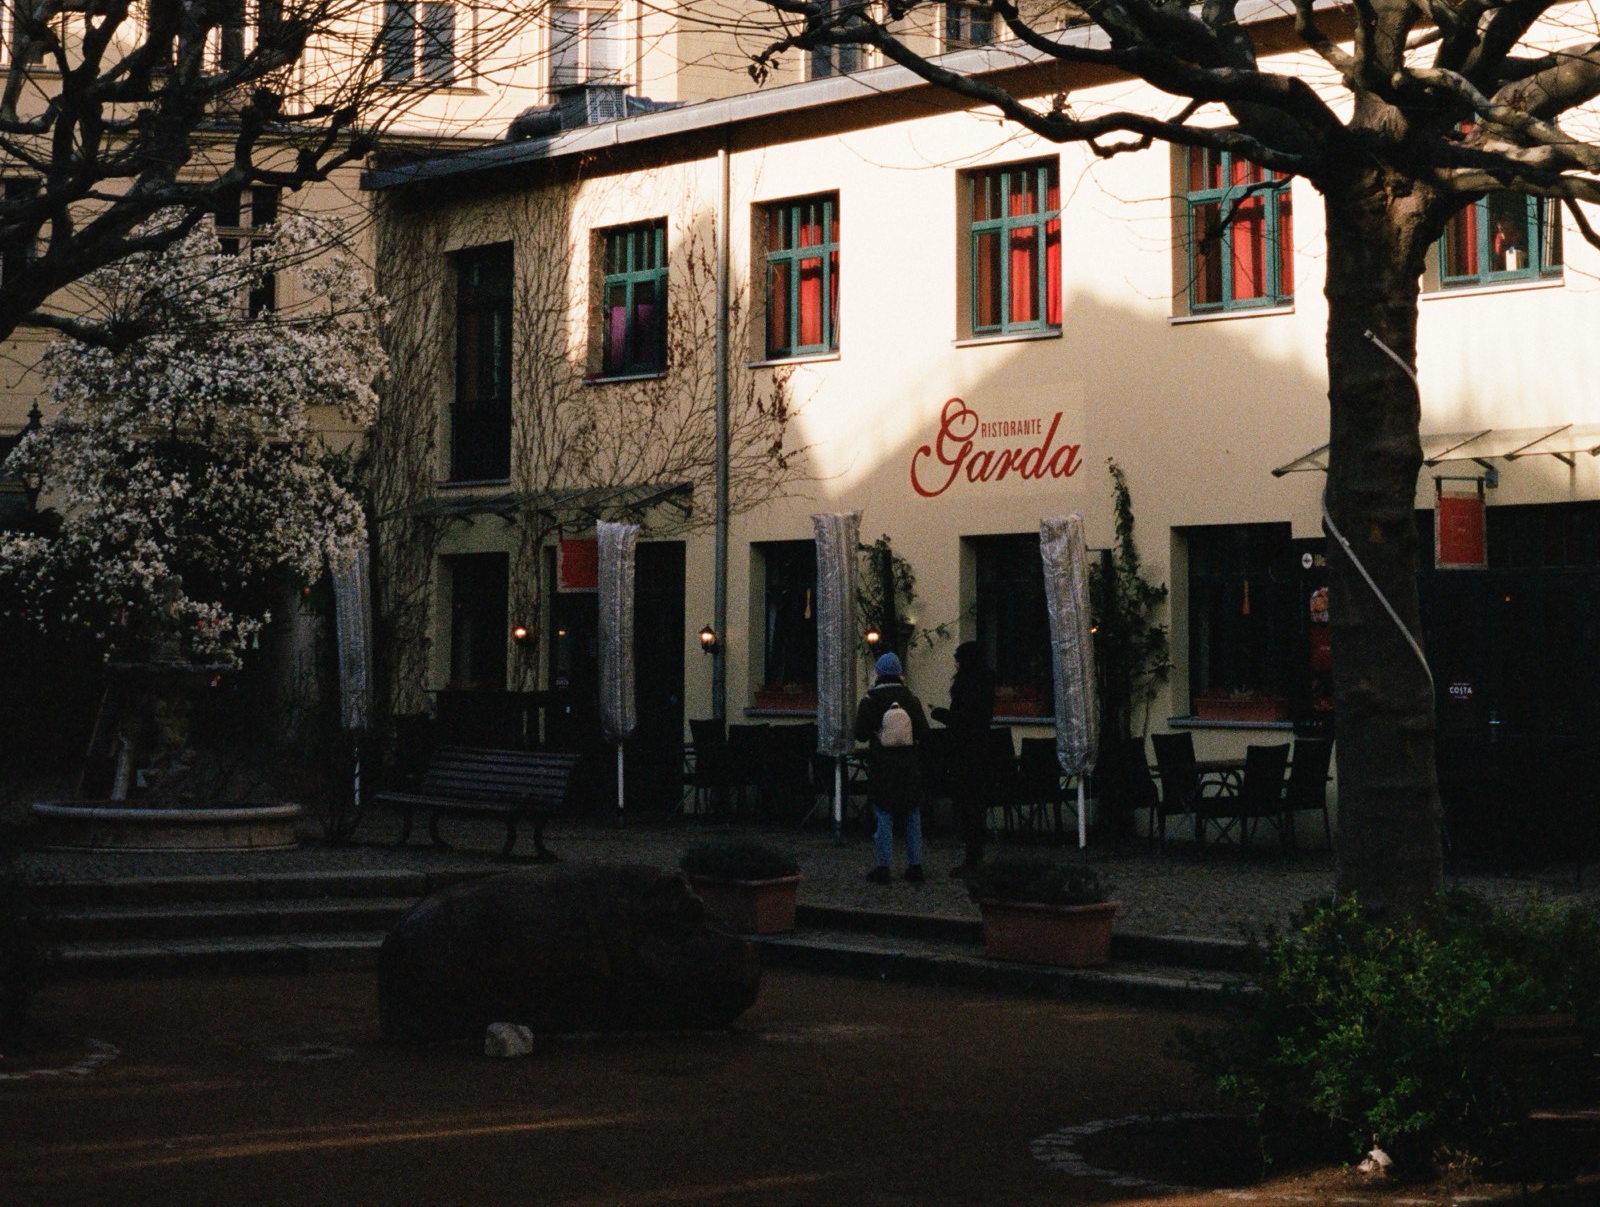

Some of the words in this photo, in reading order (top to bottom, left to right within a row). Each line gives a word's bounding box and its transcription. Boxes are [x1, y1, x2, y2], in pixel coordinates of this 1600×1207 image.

[981, 418, 1042, 438] RISTORANTE
[910, 397, 1082, 498] Garda
[1449, 686, 1473, 695] COSTA
